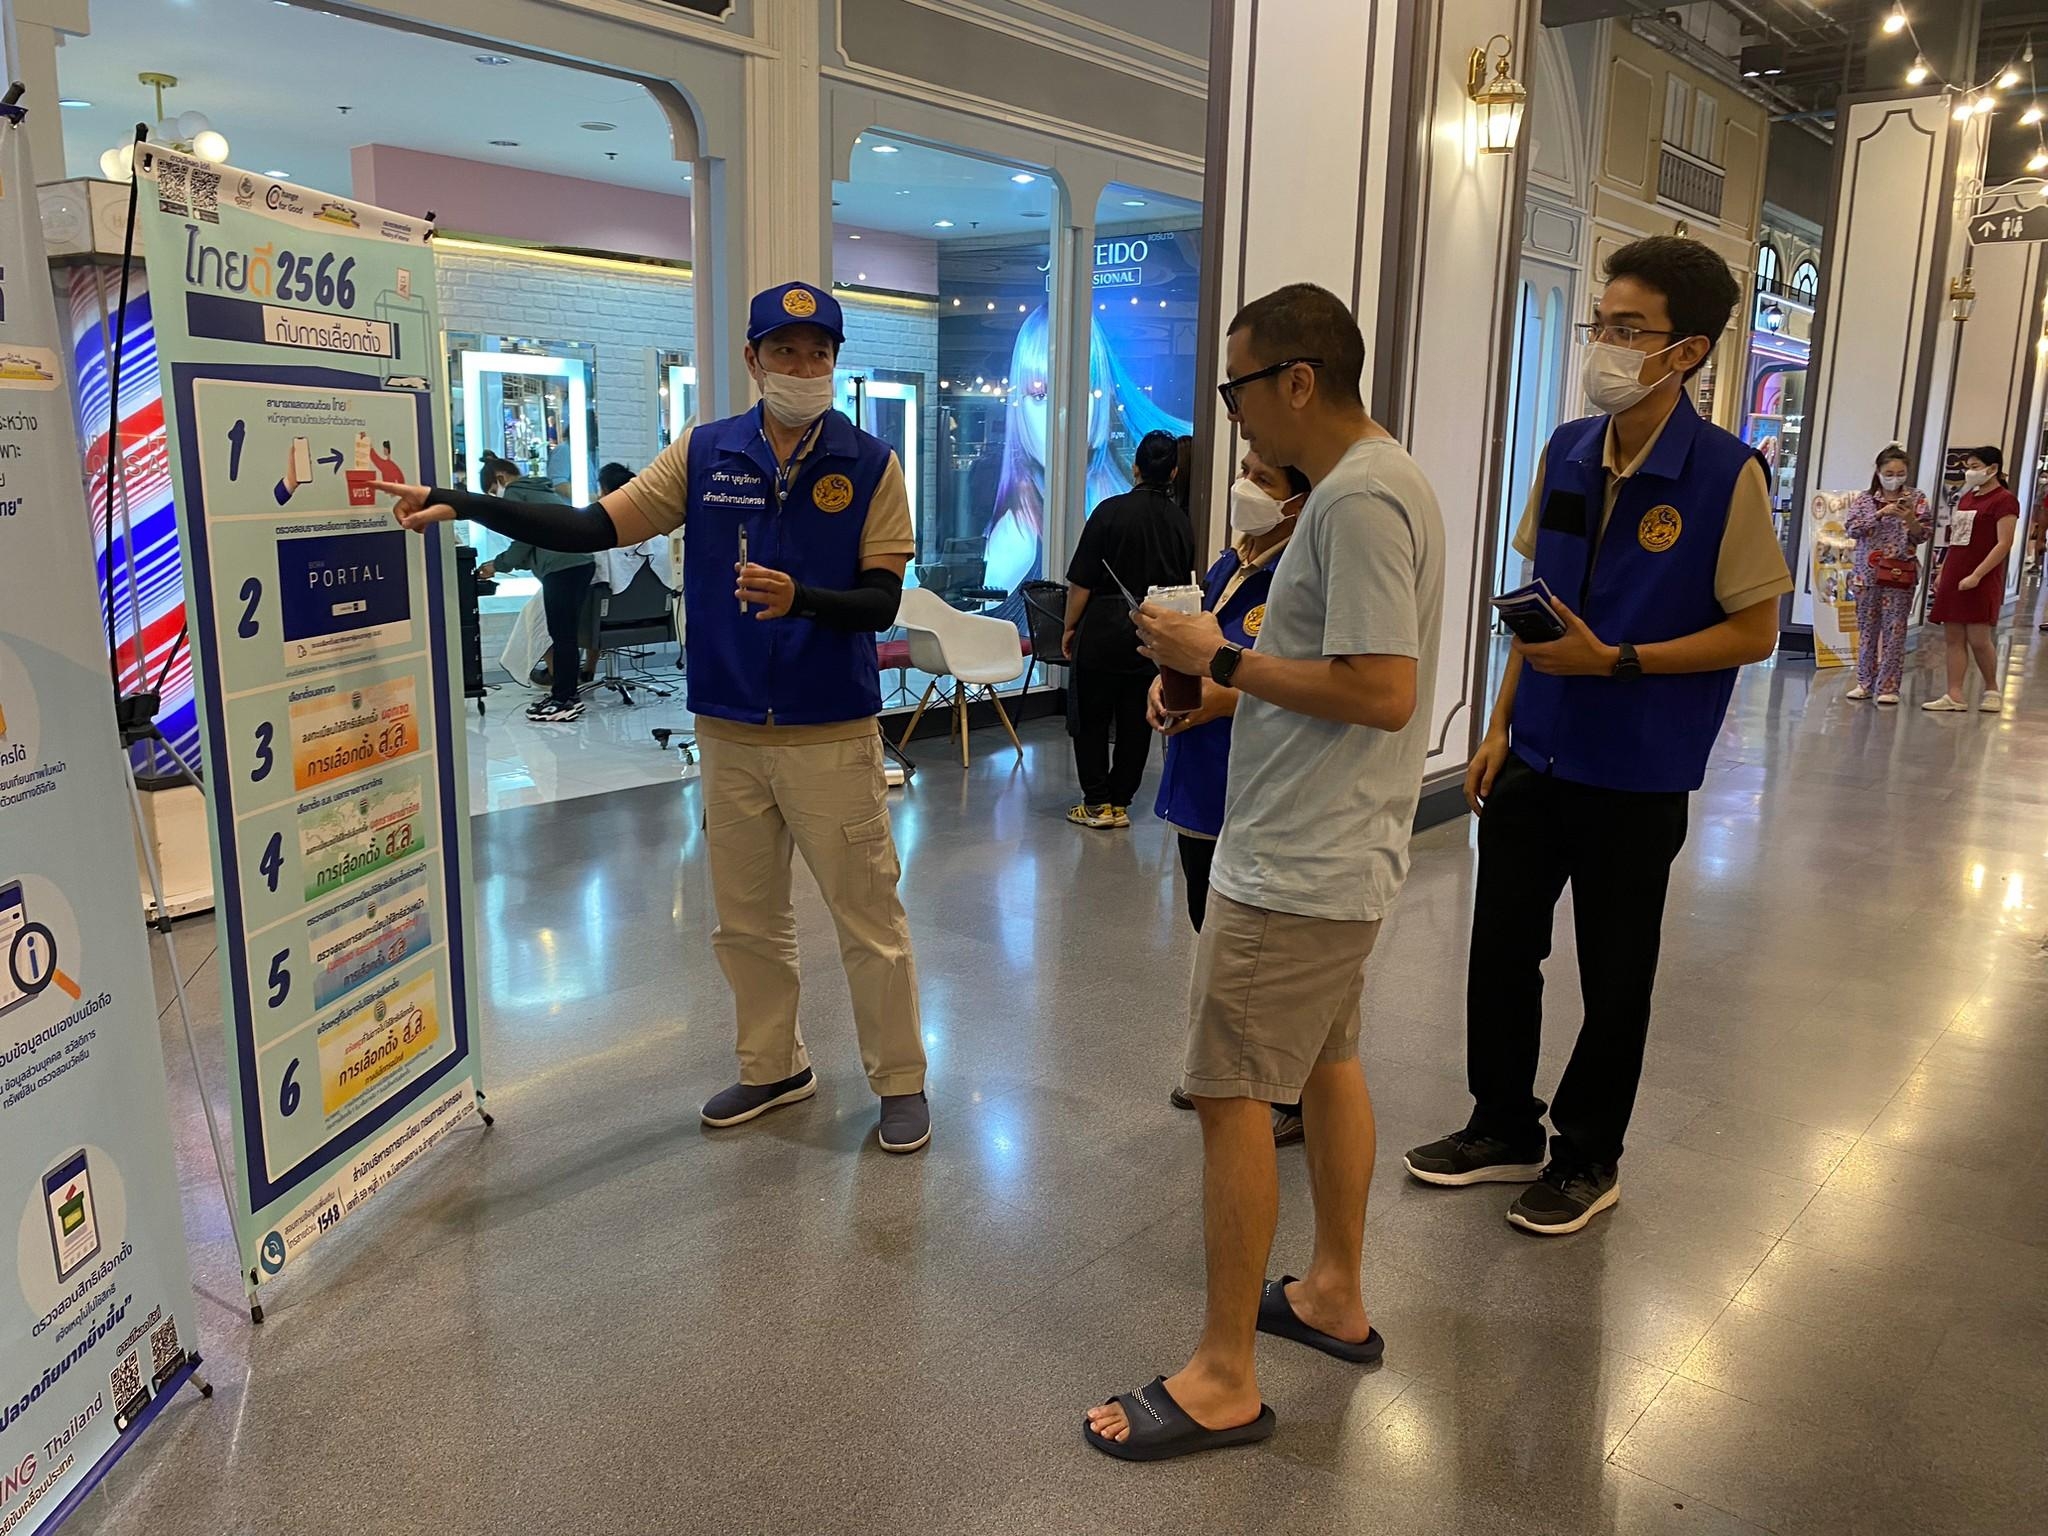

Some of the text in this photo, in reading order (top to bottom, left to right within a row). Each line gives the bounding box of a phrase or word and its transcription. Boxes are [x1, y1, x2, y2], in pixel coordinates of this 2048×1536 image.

[184, 223, 357, 310] ไทยดี 2566
[276, 316, 382, 354] กับการเลือกตั้ง
[228, 419, 246, 482] 1
[352, 487, 371, 499] VOTE
[308, 564, 385, 589] PORTAL
[237, 577, 262, 638] 2
[251, 721, 274, 783] 3
[307, 733, 374, 777] การเลือกตั้ง
[259, 831, 284, 892] 4
[316, 837, 381, 887] การเลือกตั้ง
[267, 948, 291, 1009] 5
[279, 1057, 302, 1119] 6
[338, 1029, 399, 1087] การเลือกตั้ง
[317, 1203, 342, 1235] 1548
[32, 1241, 134, 1338] ตรวจสอบสิทธิเลือกตั้ง
[43, 1391, 103, 1460] Thailand
